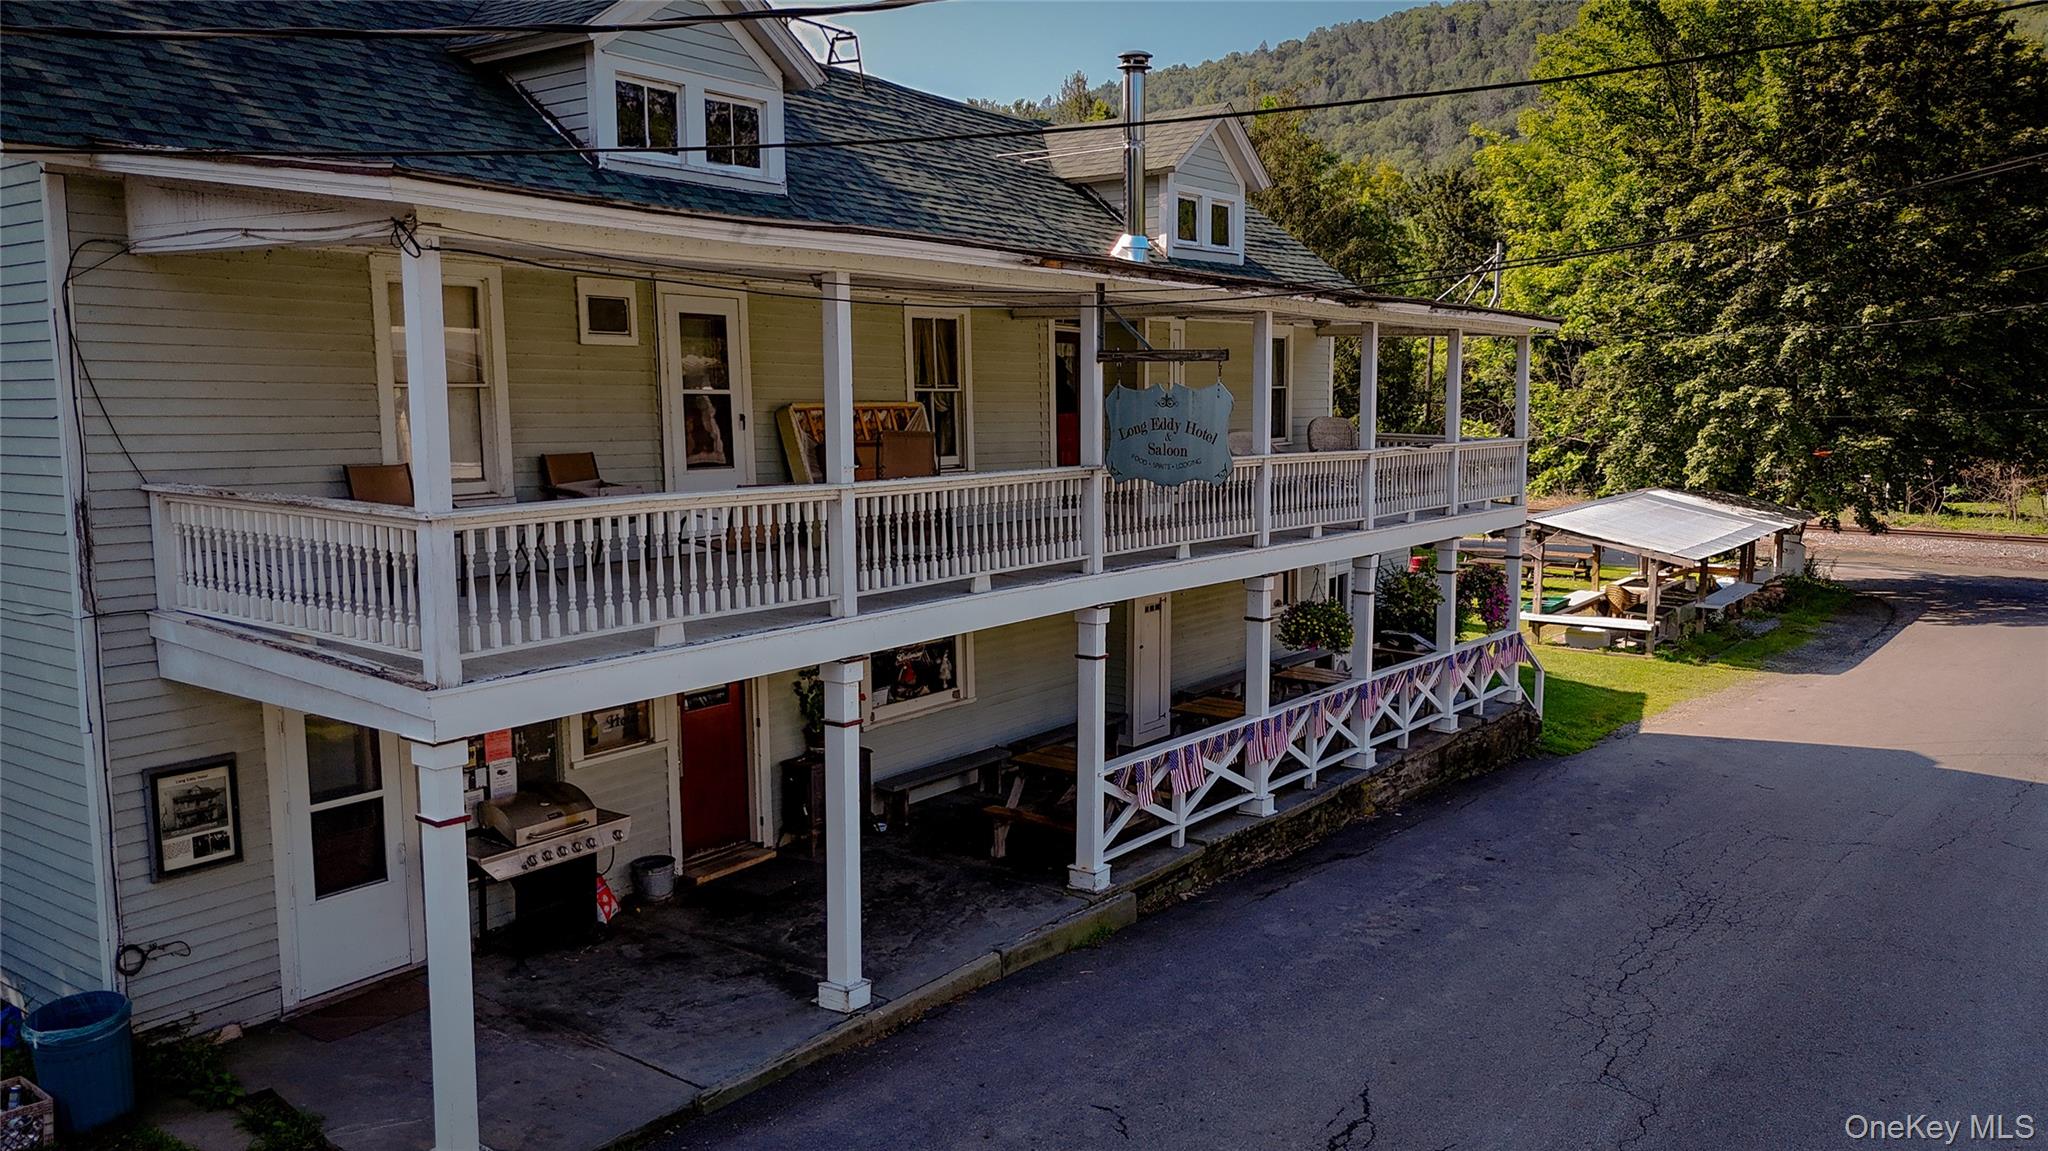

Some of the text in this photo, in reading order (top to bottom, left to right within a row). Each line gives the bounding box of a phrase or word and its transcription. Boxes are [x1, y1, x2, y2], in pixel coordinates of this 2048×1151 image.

[1118, 417, 1219, 445] Long Eddy Hotel
[1164, 433, 1172, 442] &
[1147, 442, 1188, 457] Saloon
